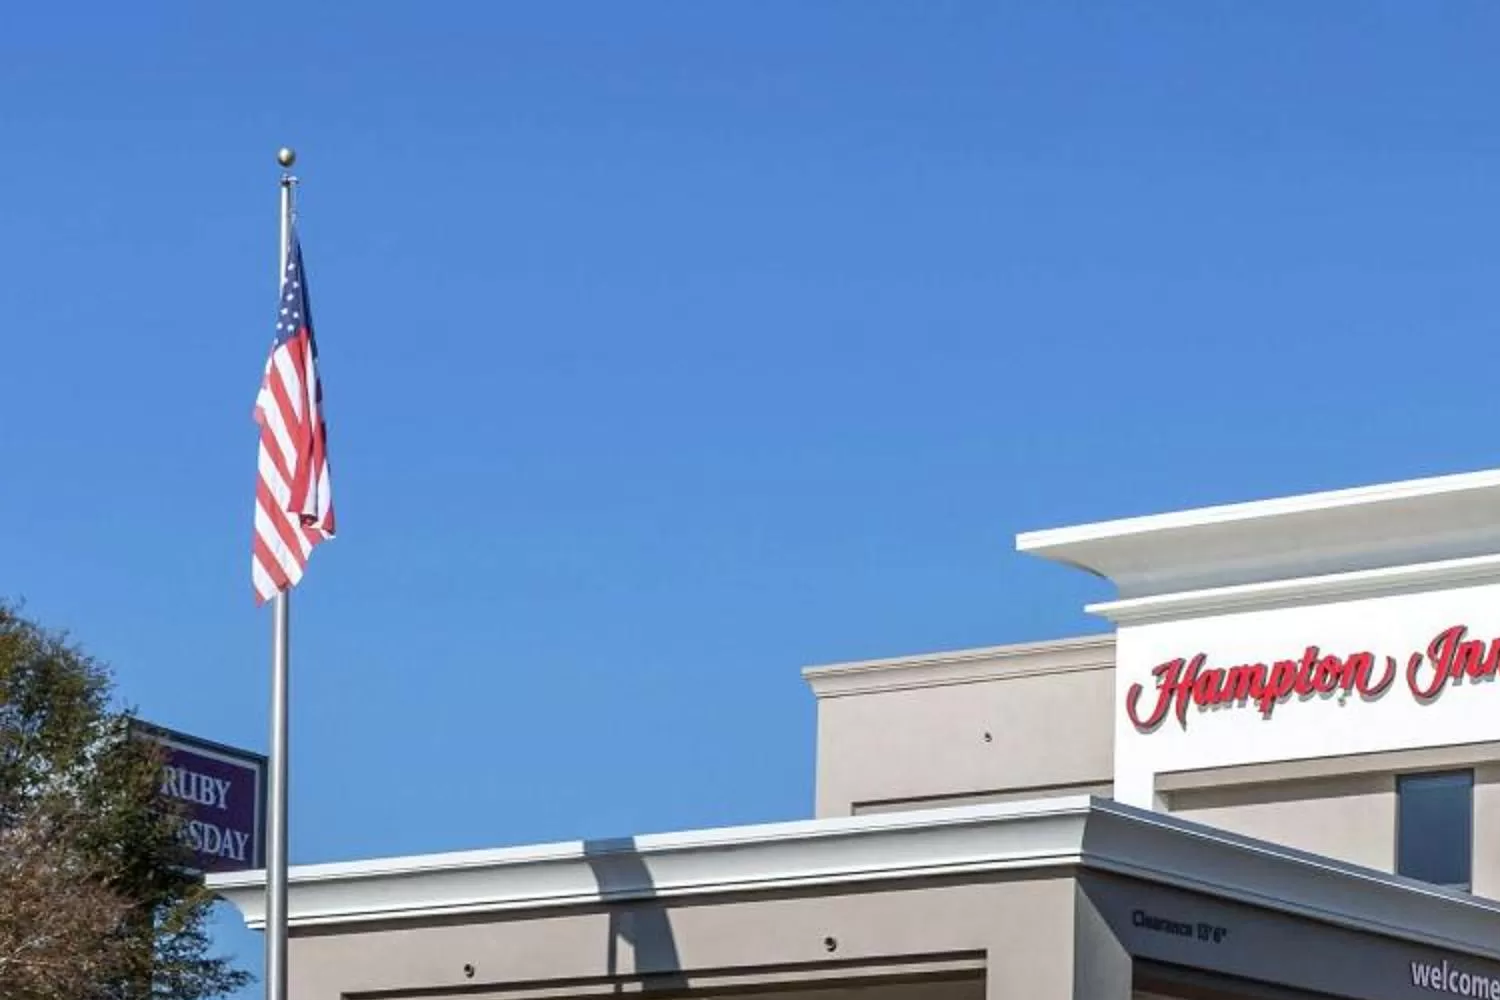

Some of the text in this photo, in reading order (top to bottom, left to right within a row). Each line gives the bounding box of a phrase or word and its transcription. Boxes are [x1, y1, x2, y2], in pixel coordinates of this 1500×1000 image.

[1126, 645, 1397, 734] Hampton
[159, 764, 232, 811] RUBY
[176, 818, 250, 861] SDAY
